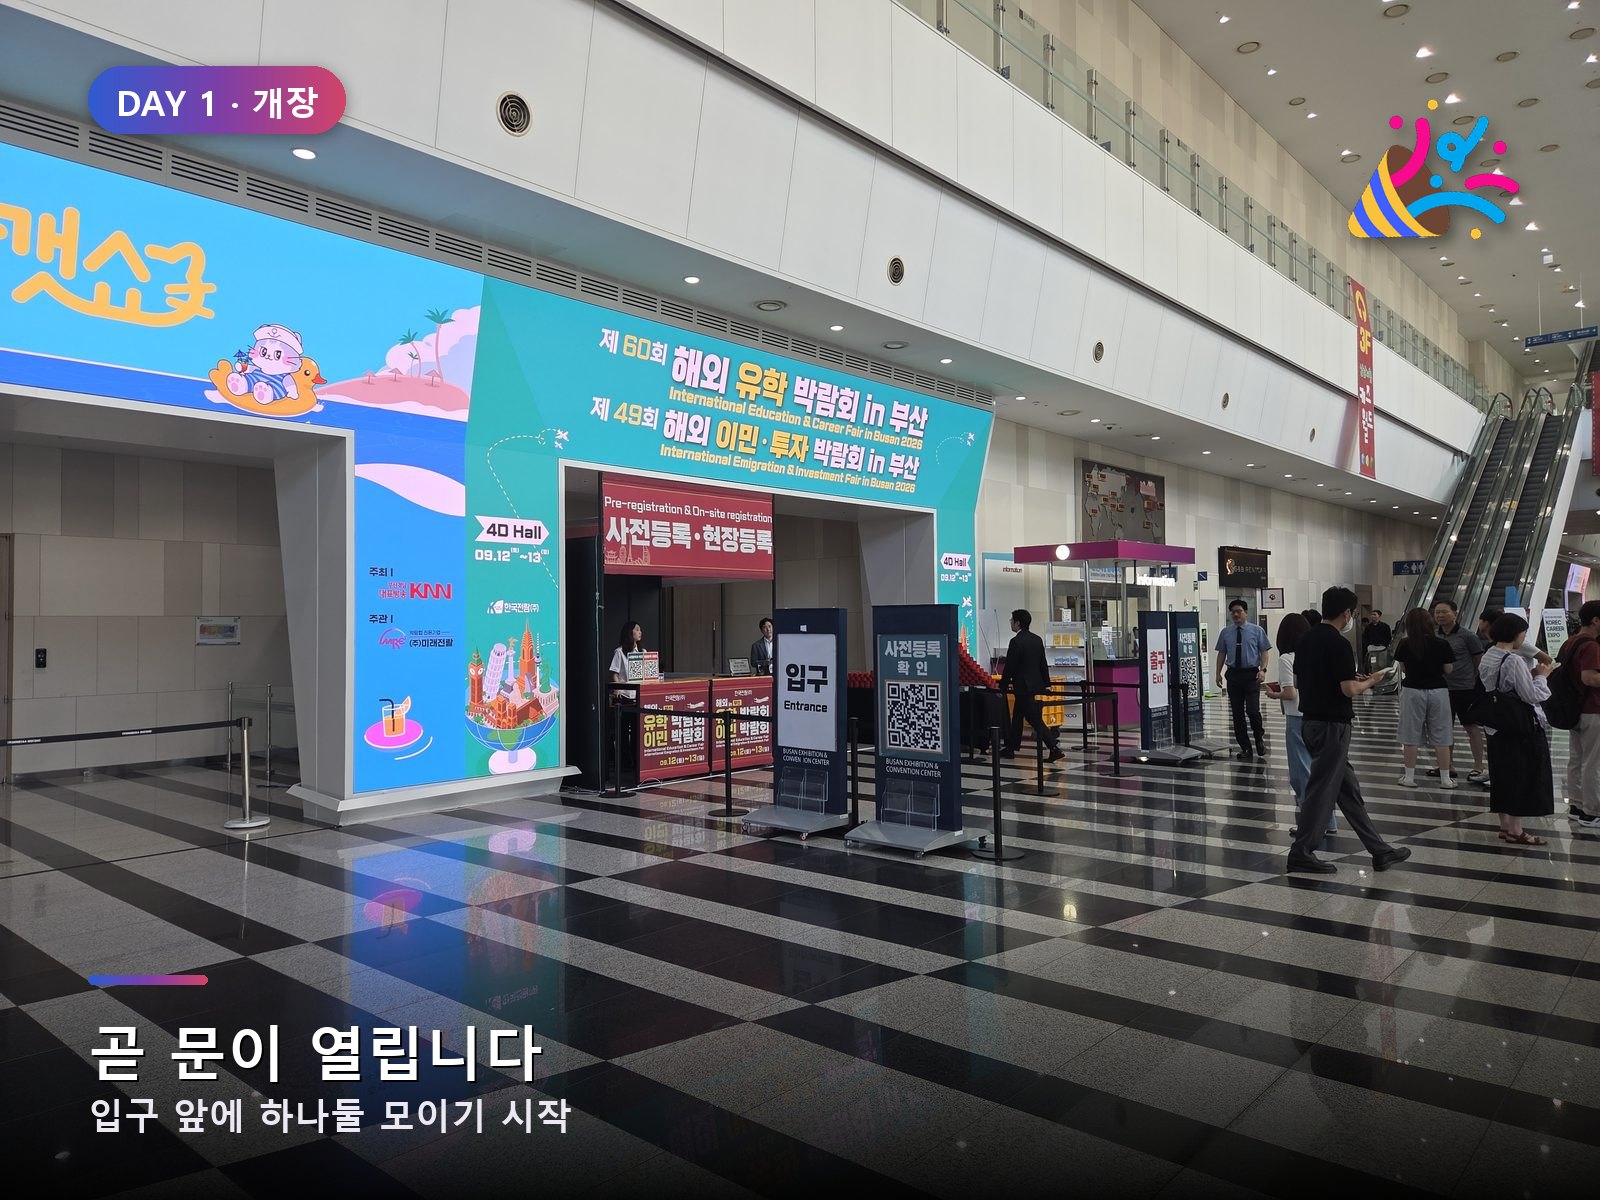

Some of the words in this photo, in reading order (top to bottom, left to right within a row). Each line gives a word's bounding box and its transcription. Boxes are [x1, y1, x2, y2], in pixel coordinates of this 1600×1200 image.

[1360, 326, 1372, 355] 3F
[599, 328, 619, 354] 제
[623, 335, 668, 366] 60회
[671, 345, 730, 394] 해외
[735, 361, 788, 407] 유학
[794, 375, 861, 423] 박람회
[863, 394, 886, 427] in
[889, 400, 928, 438] 부산
[669, 386, 747, 415] International
[748, 403, 801, 426] Education
[803, 416, 811, 429] &
[812, 418, 845, 435] Career
[845, 425, 865, 438] Fair
[864, 429, 873, 440] in
[874, 430, 900, 446] Busan
[901, 436, 923, 450] 2026
[590, 396, 611, 422] 제
[613, 402, 659, 430] 49회
[663, 409, 711, 446] 해외
[813, 437, 866, 472] 박람회
[867, 448, 886, 474] in
[888, 453, 920, 481] 부산
[660, 444, 732, 466] International
[733, 455, 785, 474] Emigration
[787, 465, 795, 475] &
[795, 465, 844, 483] Investment
[844, 474, 862, 486] Fair
[862, 476, 870, 487] in
[870, 478, 895, 491] Busan
[895, 482, 915, 493] 2026
[604, 496, 683, 515] Pre-registration
[685, 505, 692, 516] &
[692, 505, 726, 519] On-site
[727, 511, 773, 524] registration
[486, 523, 509, 537] 4D
[513, 524, 541, 540] Hall
[943, 557, 953, 566] 4D
[954, 557, 967, 567] Hall
[369, 567, 388, 577] 주최
[410, 583, 452, 599] KNN
[369, 614, 388, 624] 주관
[884, 640, 941, 659] 사전등록
[1150, 650, 1165, 670] 출구
[785, 663, 828, 694] 입구
[1153, 673, 1164, 684] Exit
[784, 700, 828, 713] Entrance
[644, 715, 668, 731] 유학
[740, 721, 769, 736] 박람회
[644, 730, 668, 747] 이민
[671, 727, 705, 744] 박람회
[783, 755, 811, 764] CONVENION
[812, 757, 829, 765] CENTER
[799, 749, 823, 758] EXHIBITION
[886, 758, 903, 766] BUSAN
[904, 759, 934, 769] EXHIBITION
[886, 766, 919, 776] CONVENTION
[920, 768, 941, 778] CENTER
